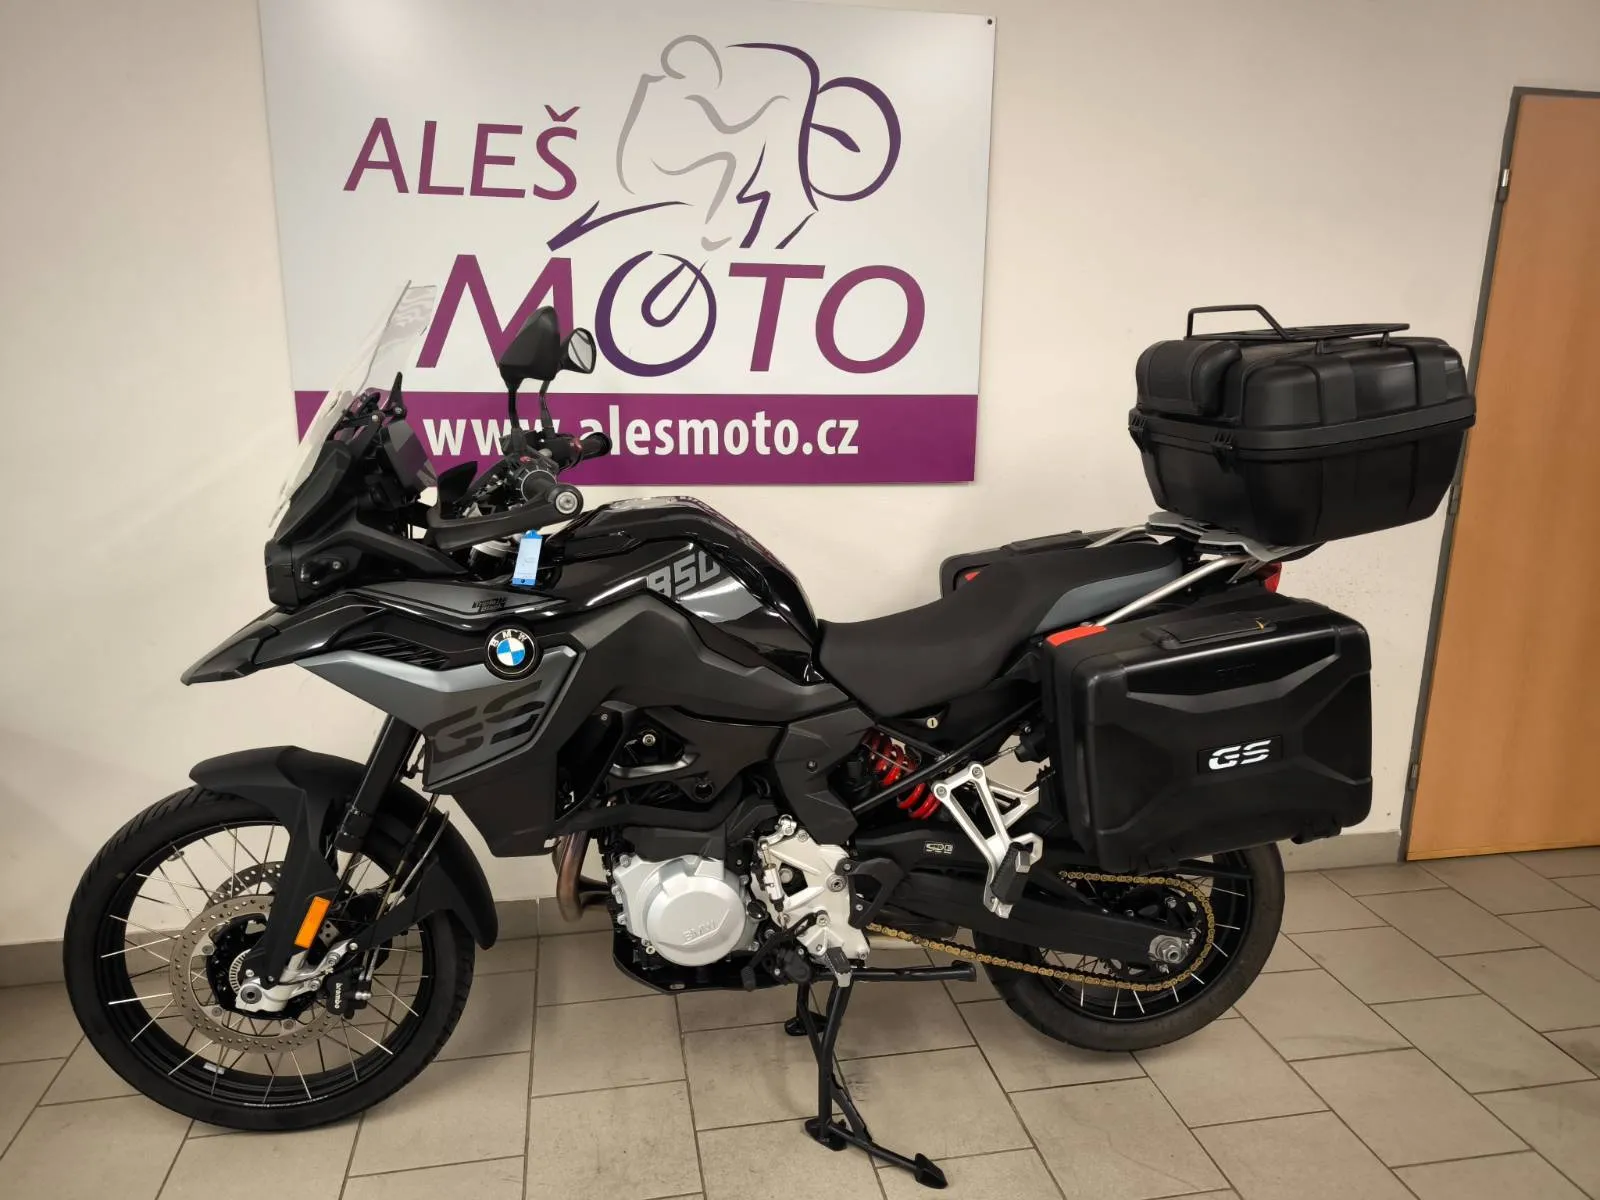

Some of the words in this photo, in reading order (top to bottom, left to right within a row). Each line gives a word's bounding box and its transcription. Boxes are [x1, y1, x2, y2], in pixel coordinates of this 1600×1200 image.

[343, 104, 580, 200] ALEŠ
[416, 251, 925, 376] MOTO
[424, 404, 860, 457] wwlesmoto.cz
[488, 630, 529, 648] BMW
[422, 680, 546, 763] GS
[1208, 739, 1271, 770] GS
